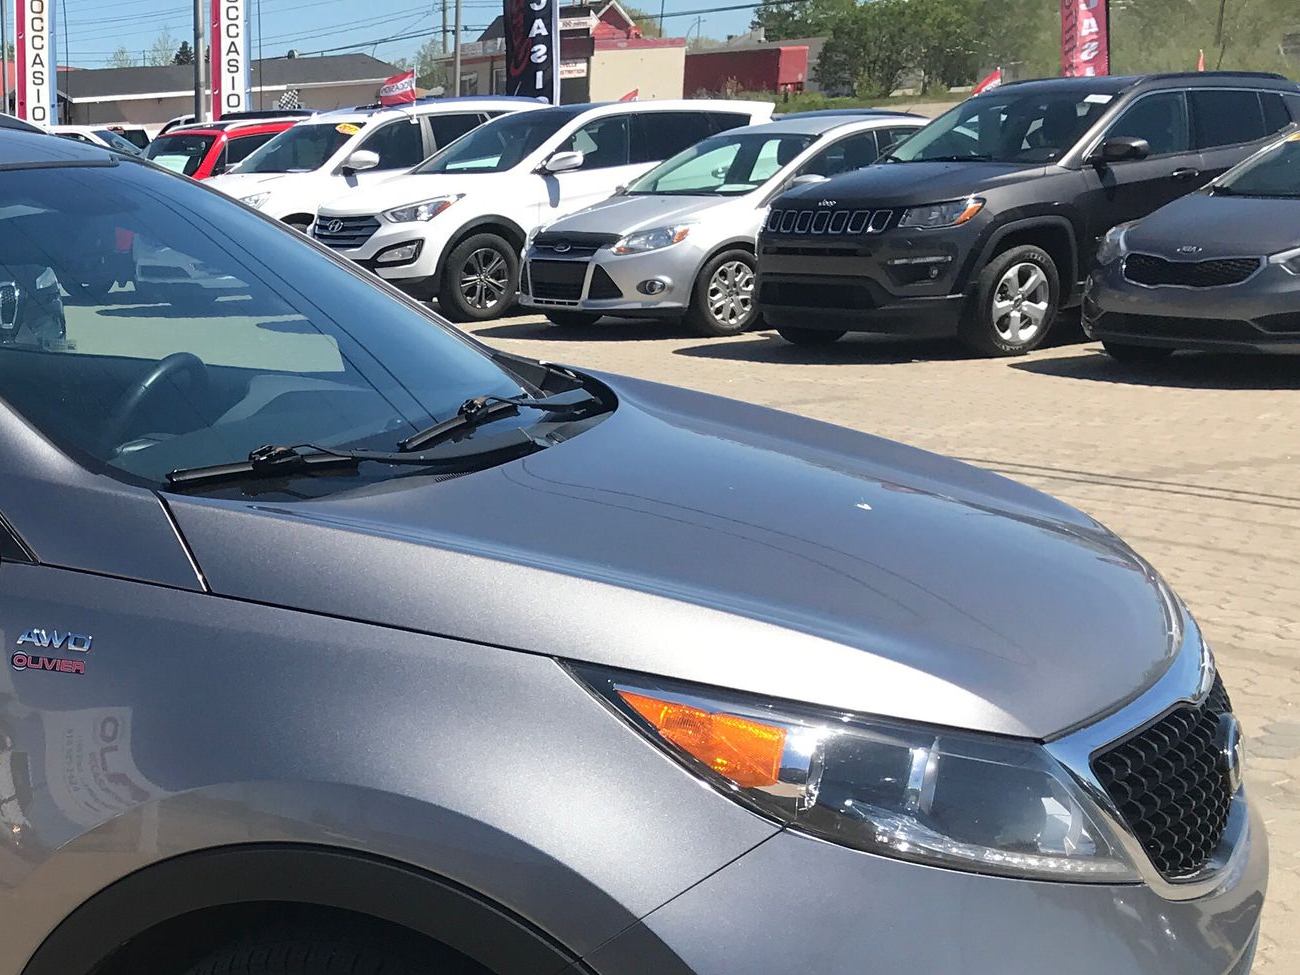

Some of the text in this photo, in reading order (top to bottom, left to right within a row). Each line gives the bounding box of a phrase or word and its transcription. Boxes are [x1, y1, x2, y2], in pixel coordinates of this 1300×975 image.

[30, 0, 46, 124] OCCASIO
[226, 0, 241, 113] CCASIO
[12, 652, 85, 674] OLIVIER
[17, 628, 92, 652] AWD
